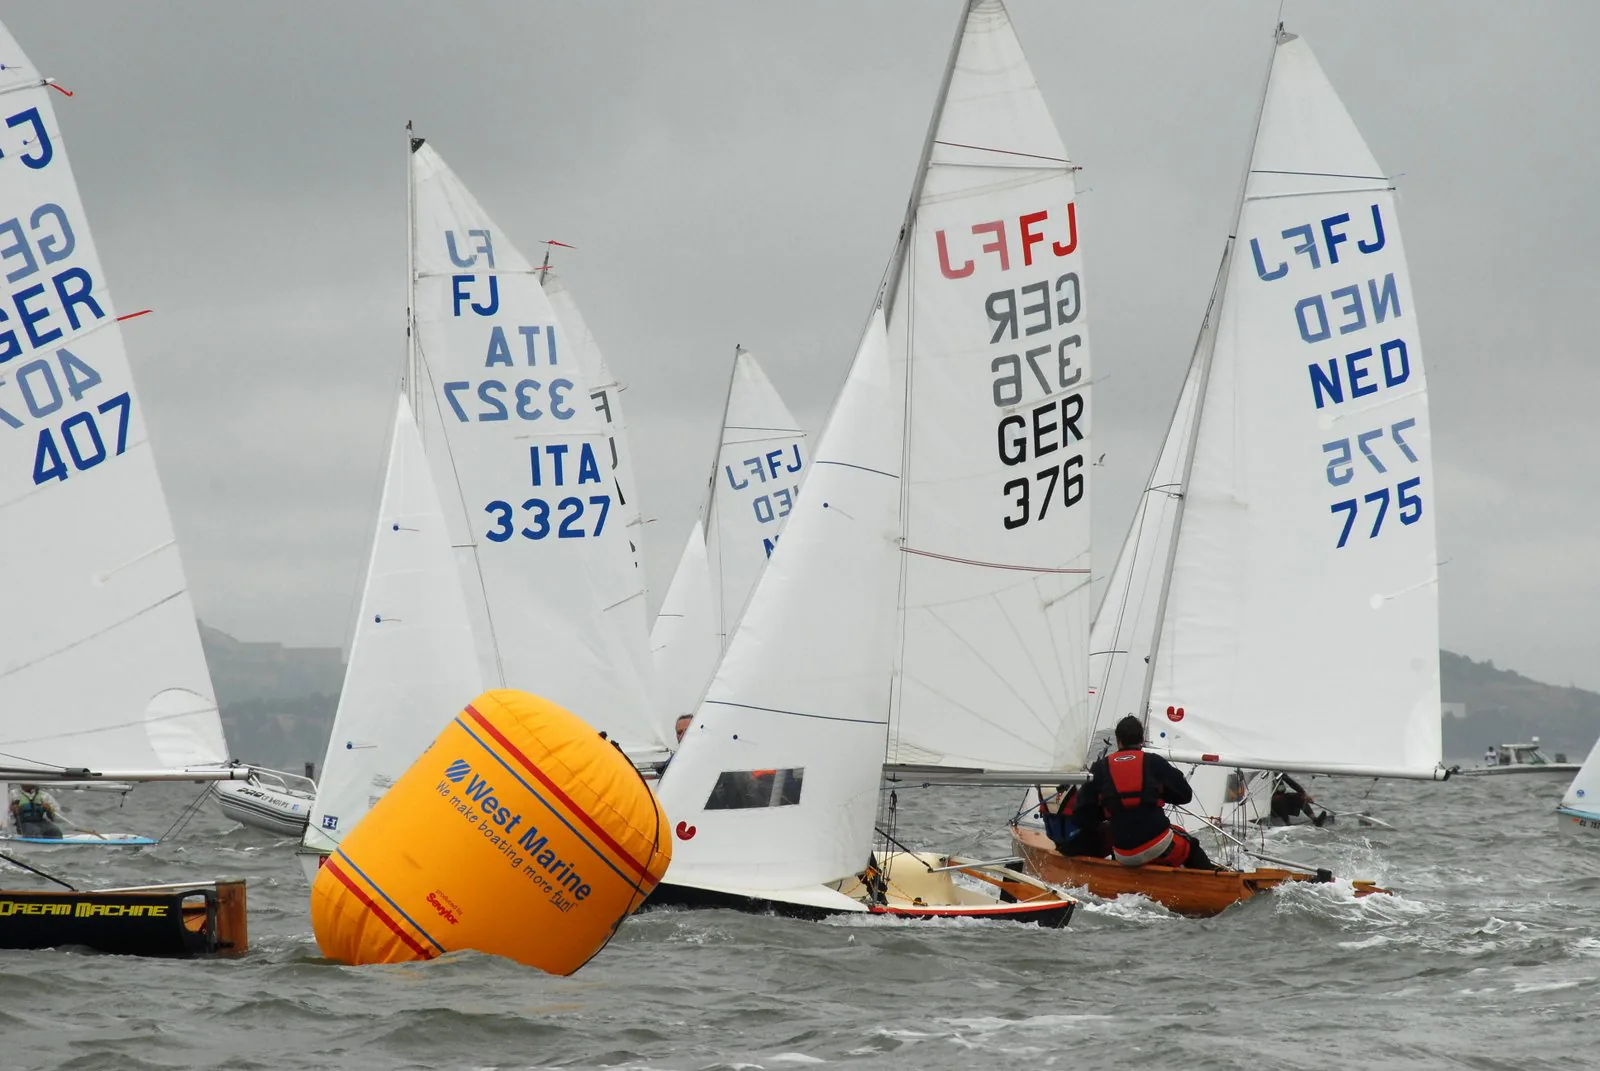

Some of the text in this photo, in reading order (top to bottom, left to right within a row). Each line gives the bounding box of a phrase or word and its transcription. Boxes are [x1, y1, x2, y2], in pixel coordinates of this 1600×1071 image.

[0, 107, 53, 169] J
[1019, 202, 1077, 266] FJ
[1321, 204, 1386, 264] FJ
[452, 275, 499, 316] FJ
[1308, 338, 1411, 409] NED
[33, 392, 131, 485] 407
[766, 444, 802, 479] FJ
[997, 393, 1084, 466] GER
[530, 443, 601, 486] ITA
[1003, 454, 1084, 530] 376
[484, 495, 611, 542] 3327
[1331, 476, 1422, 549] 775
[436, 780, 450, 796] We
[449, 796, 478, 823] make
[478, 820, 523, 868] boating
[523, 865, 553, 893] more
[465, 773, 592, 901] West Marine
[426, 892, 459, 925] Sevylor
